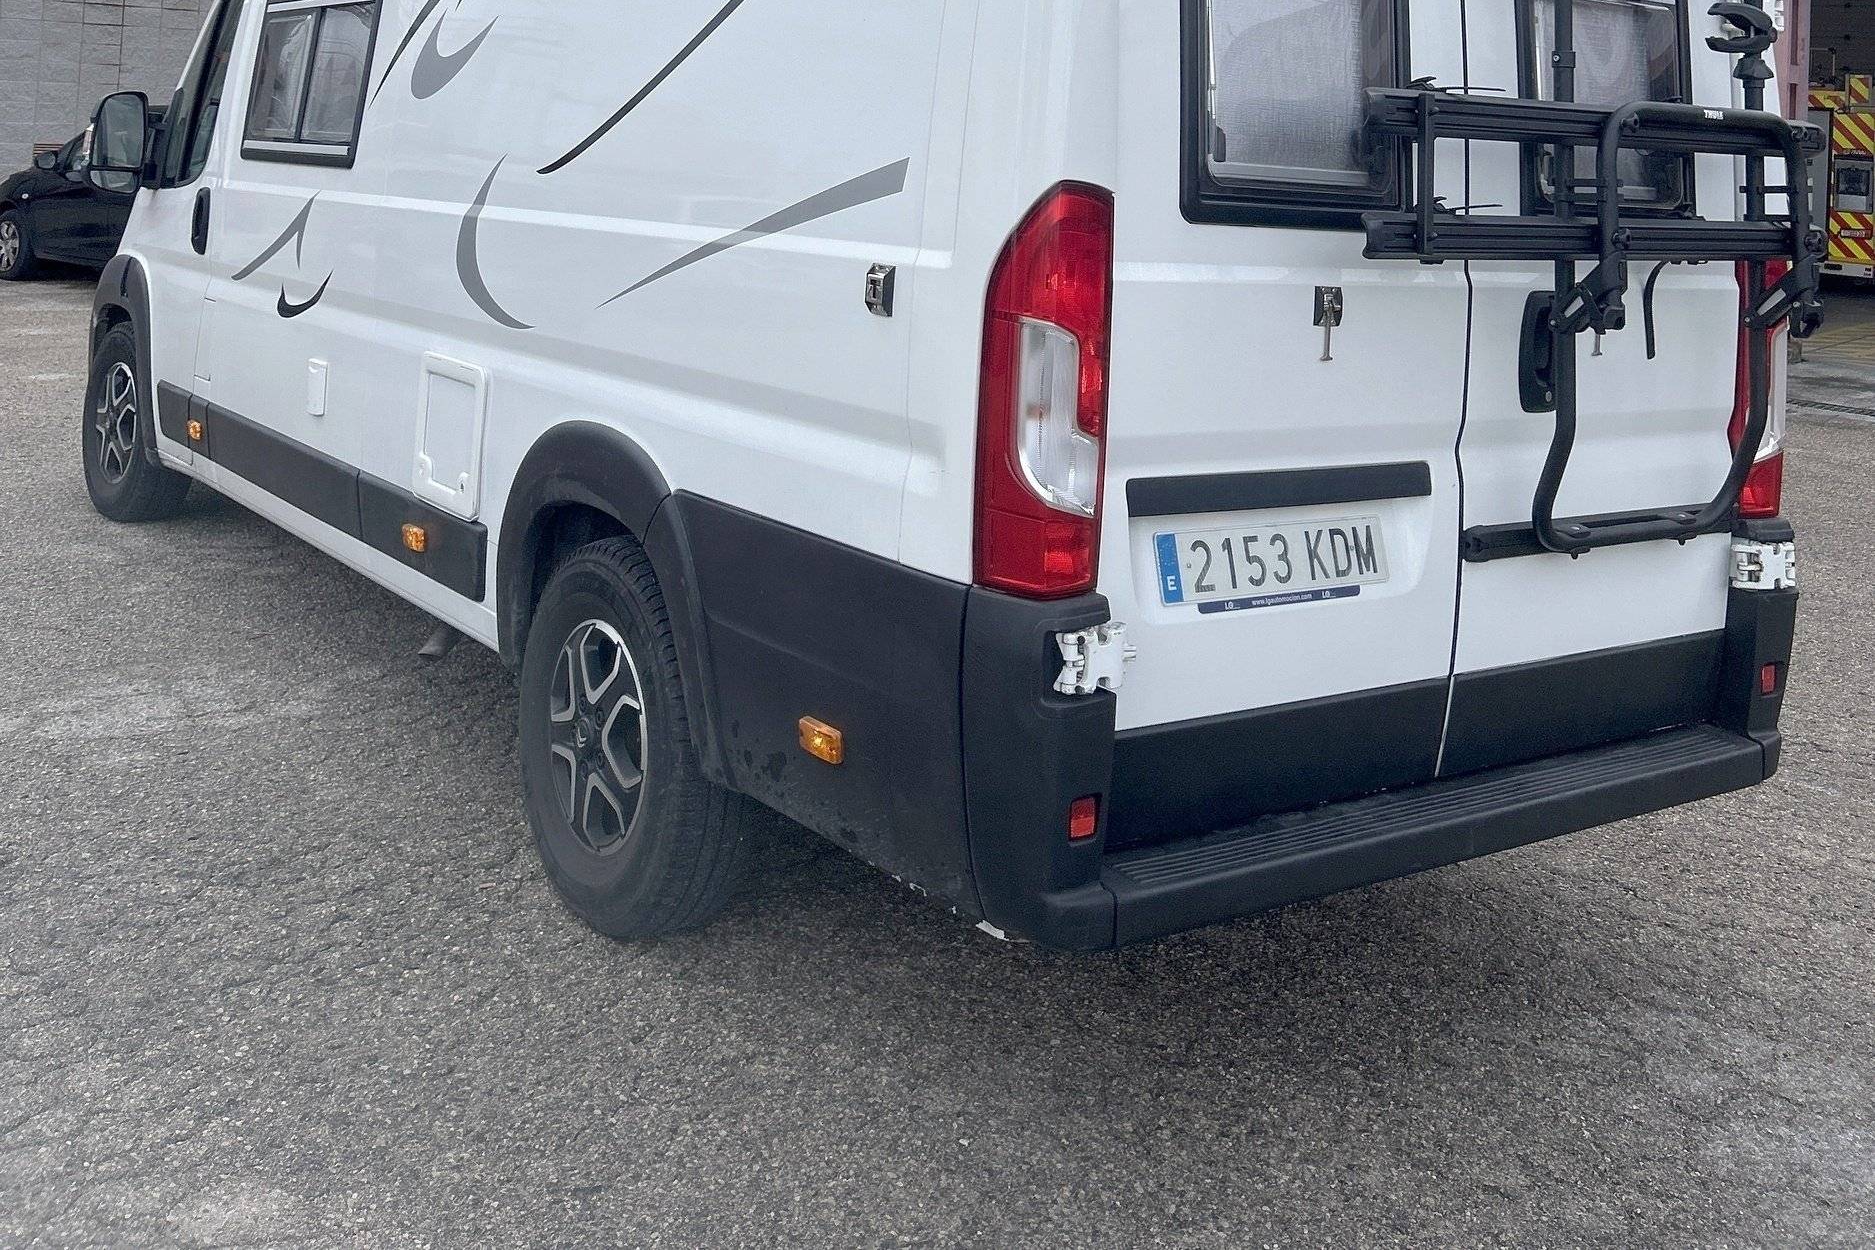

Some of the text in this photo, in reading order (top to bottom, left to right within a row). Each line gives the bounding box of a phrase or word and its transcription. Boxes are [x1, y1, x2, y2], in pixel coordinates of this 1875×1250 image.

[1190, 525, 1378, 593] 2153 KDM
[1167, 576, 1177, 591] E
